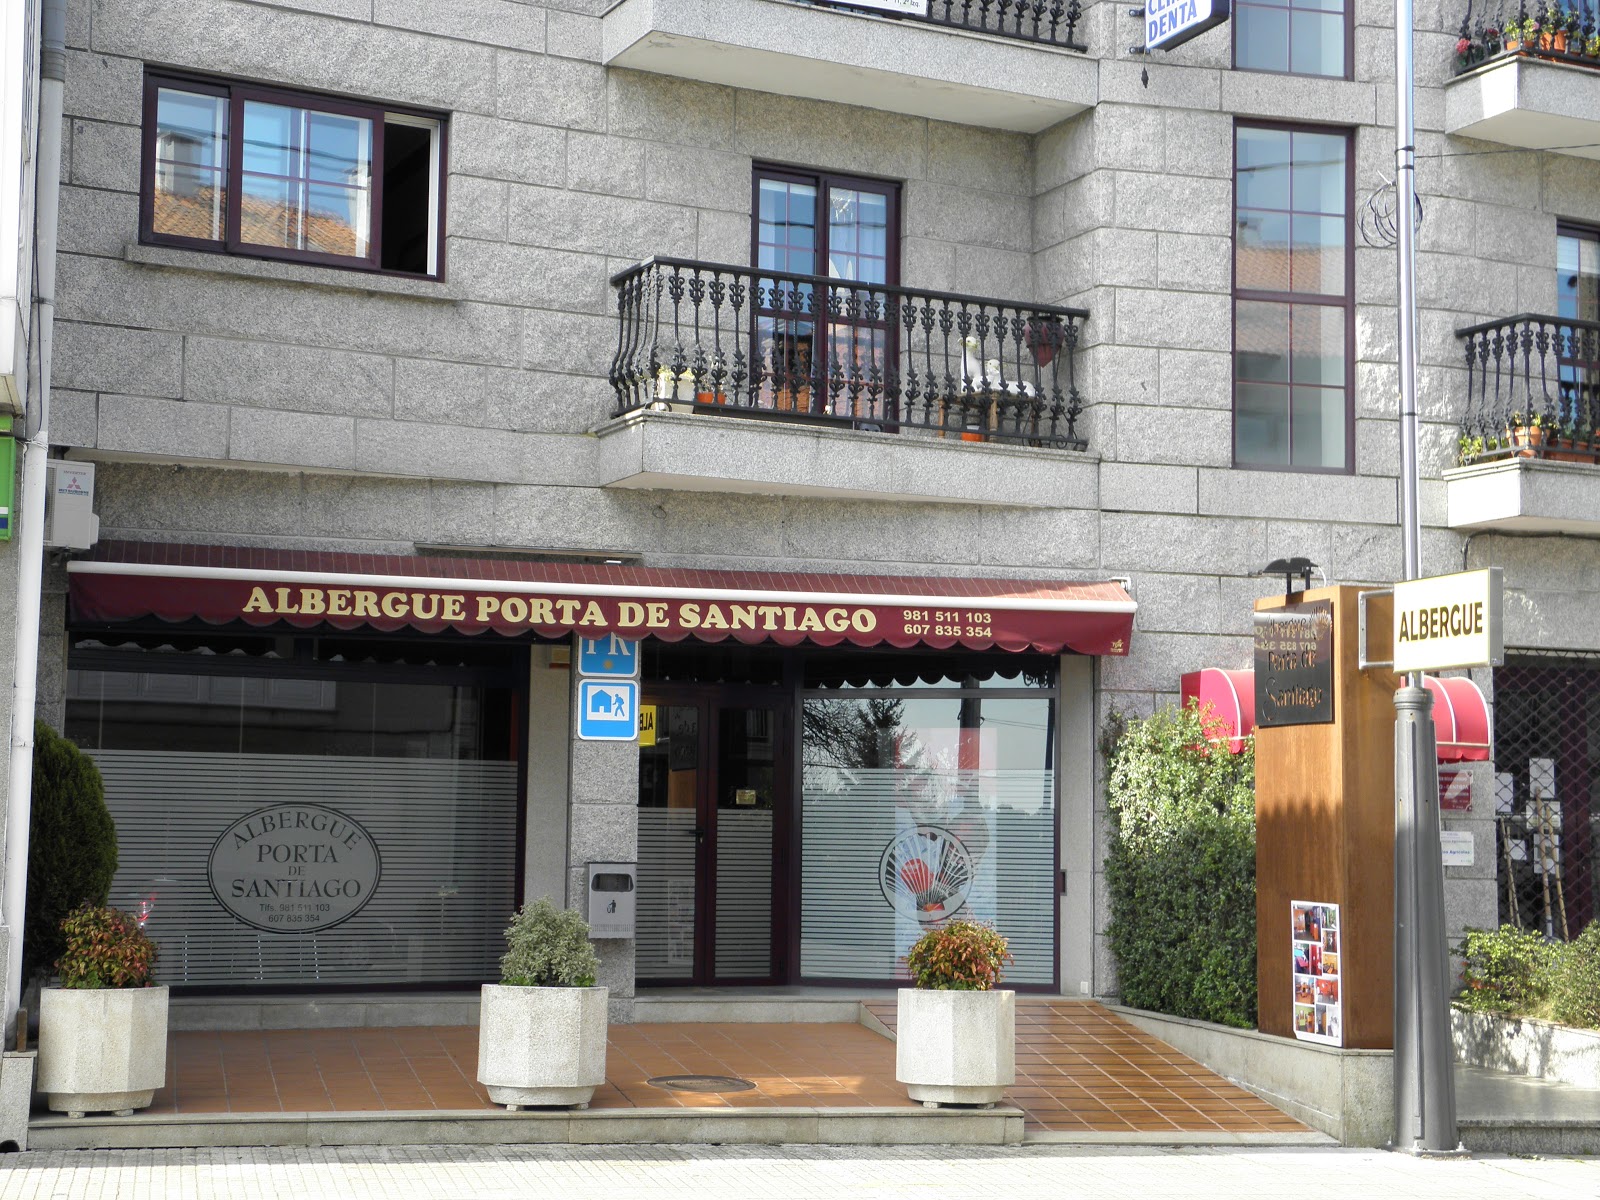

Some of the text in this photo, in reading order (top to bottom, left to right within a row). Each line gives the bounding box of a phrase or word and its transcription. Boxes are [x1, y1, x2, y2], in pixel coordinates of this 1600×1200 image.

[242, 586, 877, 633] ALBERGUE PORTA DE SANTIAGO
[903, 610, 992, 624] 981 511 103
[1398, 601, 1483, 643] ALBERGUE
[903, 624, 993, 638] 607 835 354
[232, 811, 362, 850] ALBERGUE
[256, 844, 339, 863] PORTA
[287, 865, 306, 876] DE
[231, 878, 361, 898] SANTIAGO
[279, 904, 294, 912] 981
[297, 904, 312, 912] 511
[315, 904, 330, 912] 103
[268, 914, 320, 922] 607 835 354
